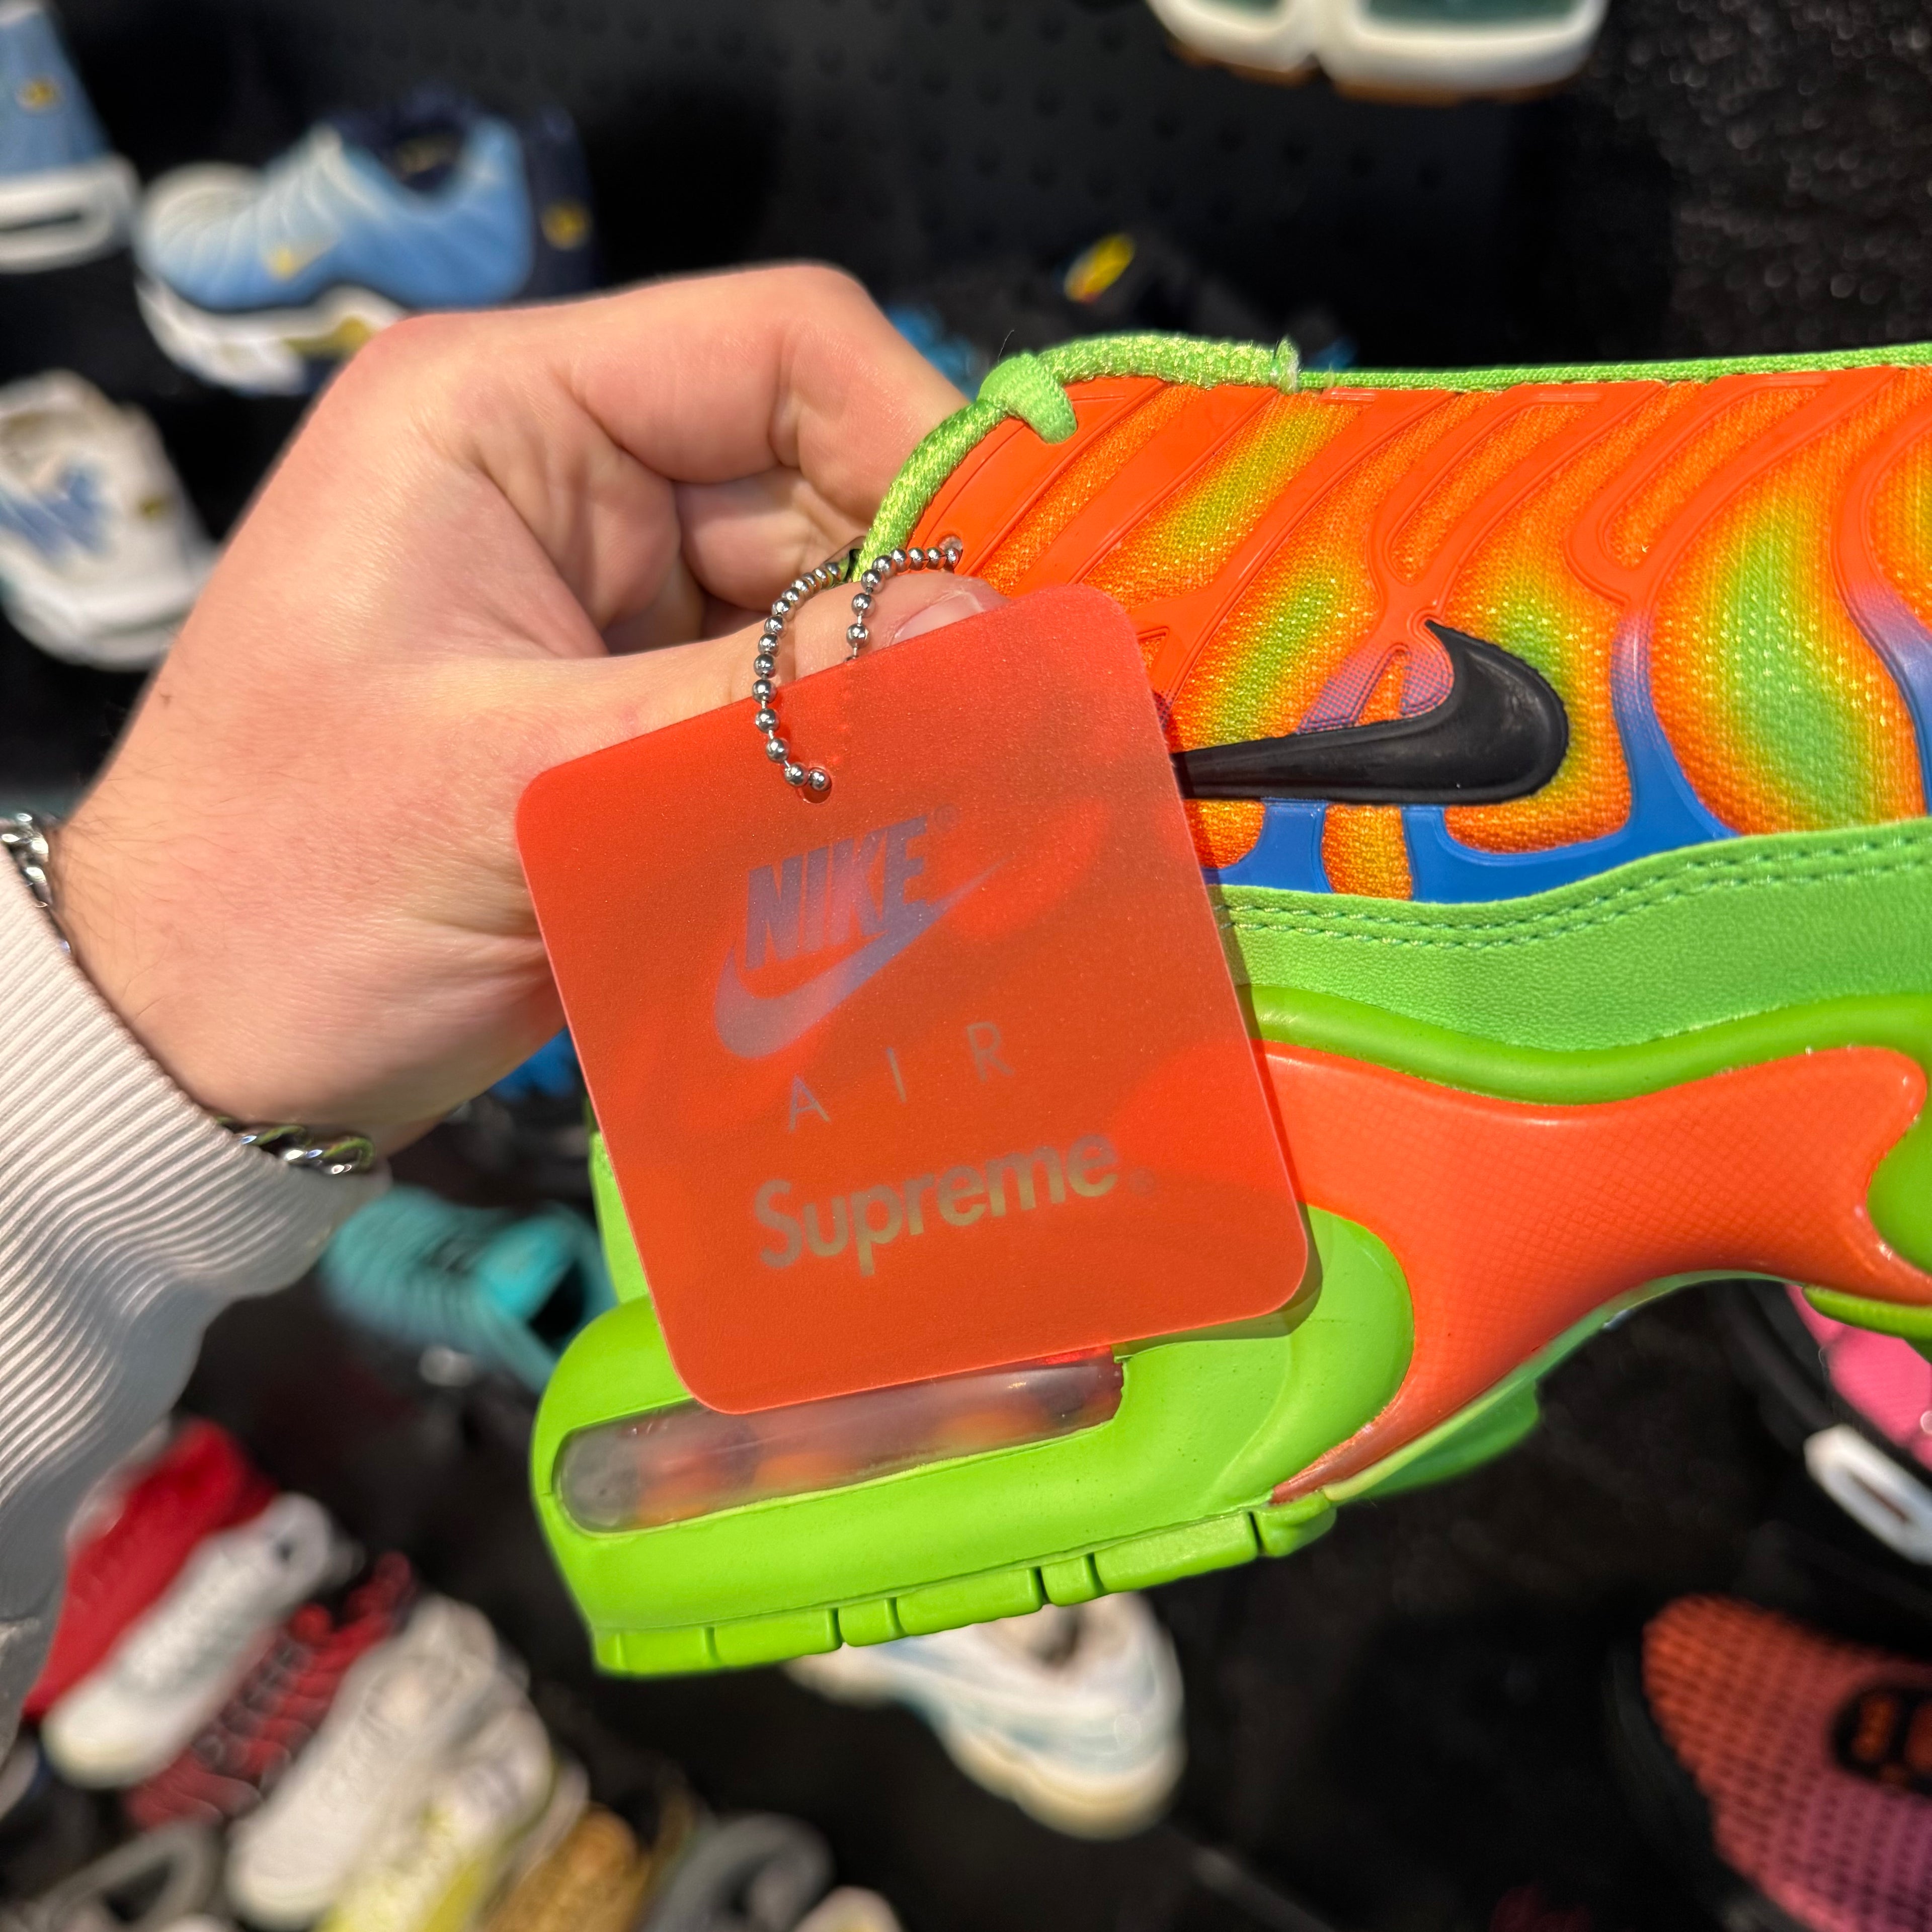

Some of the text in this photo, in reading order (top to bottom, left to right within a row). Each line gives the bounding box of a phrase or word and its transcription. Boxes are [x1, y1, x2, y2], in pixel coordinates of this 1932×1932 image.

[746, 816, 927, 971] NIKE
[788, 1021, 1014, 1132] AIR
[754, 1134, 1118, 1276] Supreme
